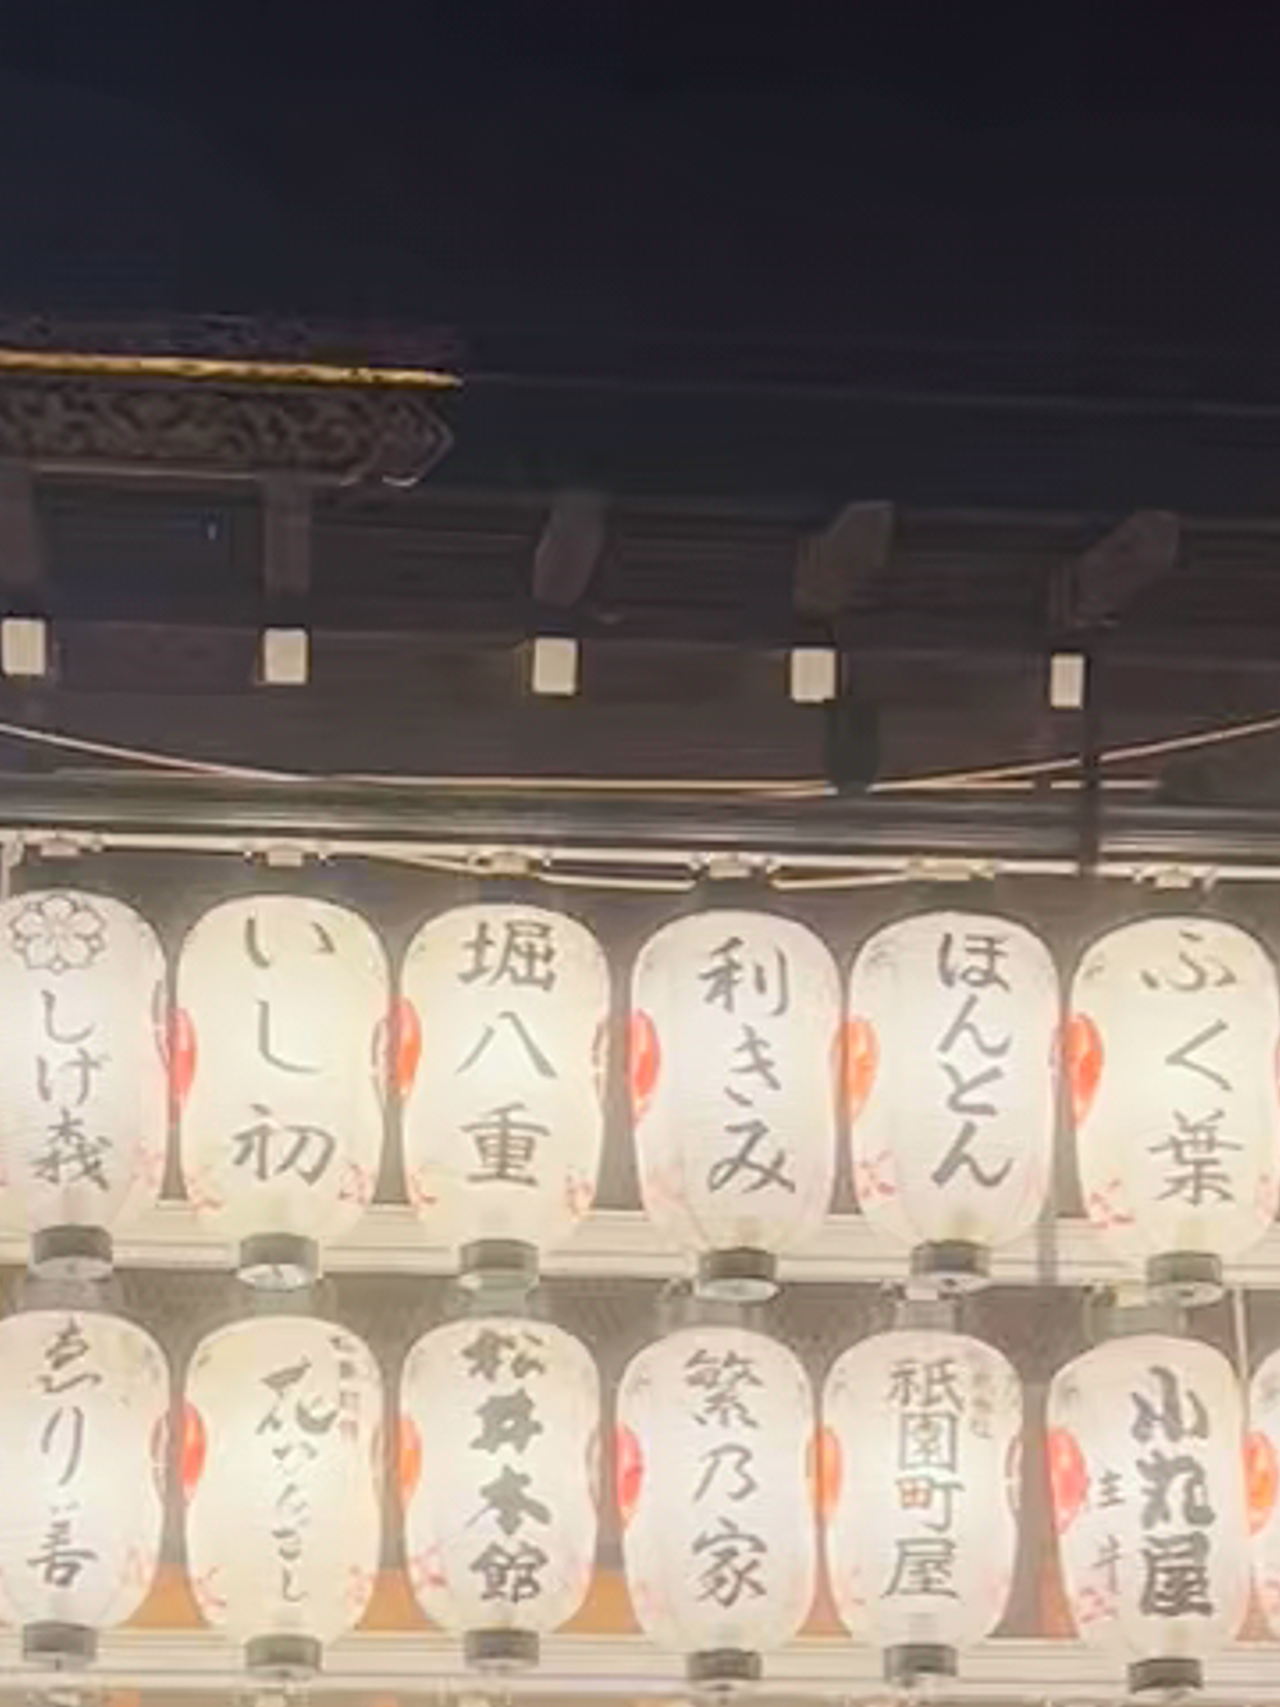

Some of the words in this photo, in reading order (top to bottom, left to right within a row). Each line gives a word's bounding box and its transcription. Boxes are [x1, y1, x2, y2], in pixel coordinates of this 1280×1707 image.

[231, 914, 338, 1187] いし初
[455, 920, 559, 1189] 堀八重
[698, 936, 796, 1195] 利きみ
[931, 932, 1013, 1189] ほんとん
[1140, 930, 1243, 1207] ふく葉
[26, 1319, 100, 1590] ゑり善
[465, 1328, 552, 1603] 松井本館
[1130, 1365, 1216, 1619] 小丸屋
